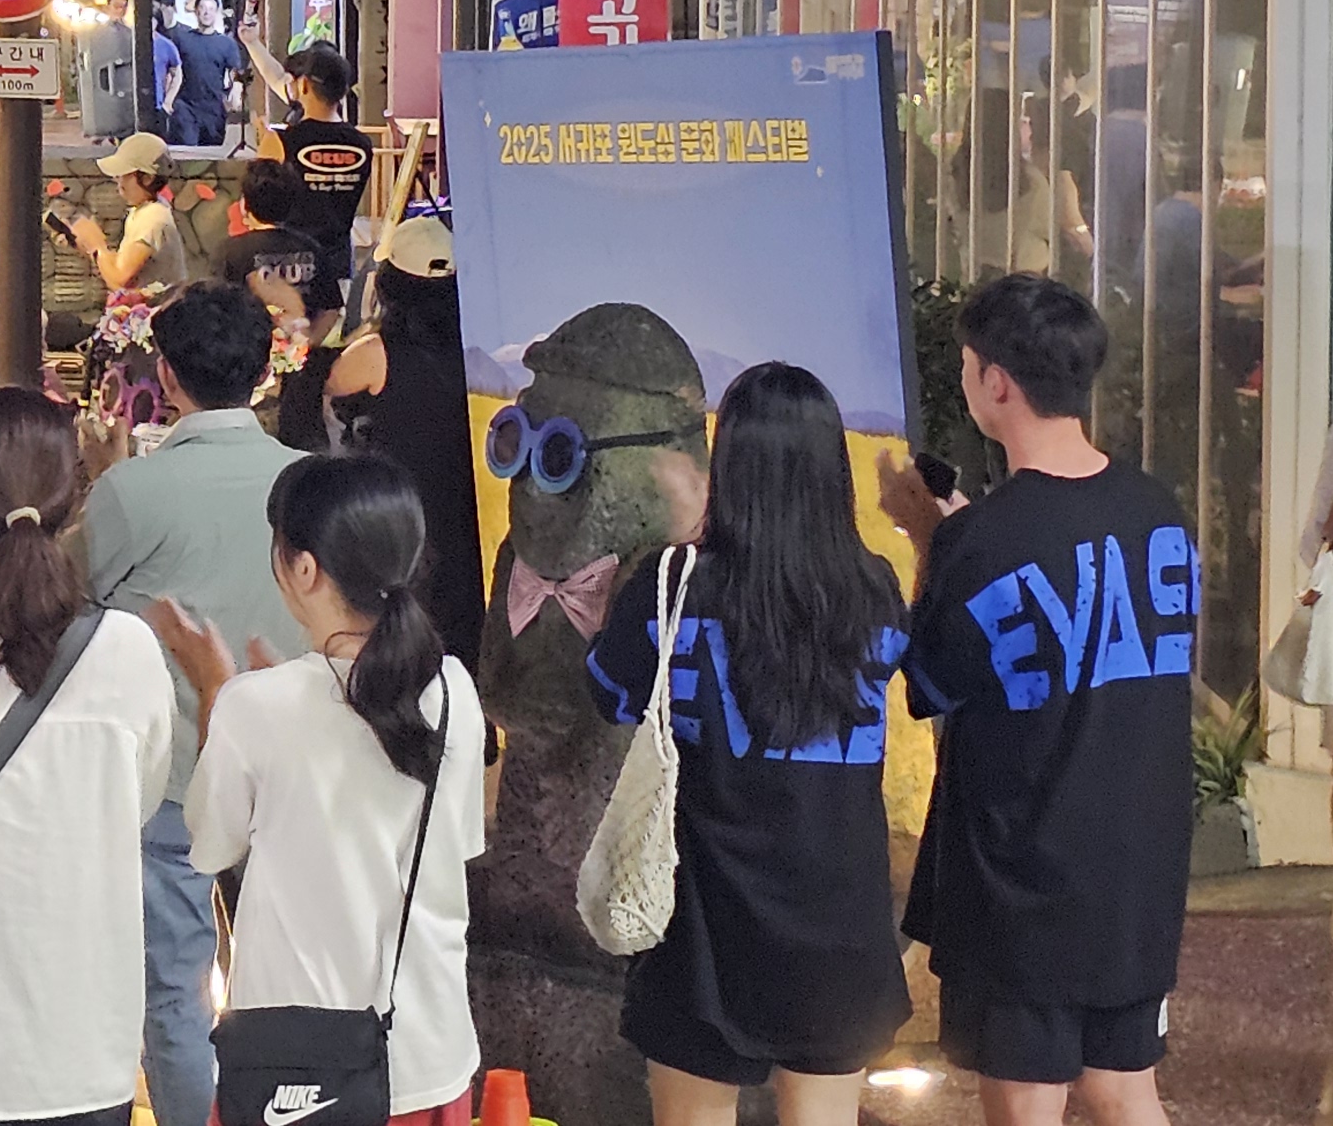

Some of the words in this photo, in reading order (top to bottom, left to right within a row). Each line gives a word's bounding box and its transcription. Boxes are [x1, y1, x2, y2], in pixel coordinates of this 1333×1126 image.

[2, 79, 34, 90] 100m
[499, 123, 554, 164] 2025
[558, 121, 614, 164] 서귀포
[617, 121, 676, 164] 원도심
[679, 119, 720, 163] 문화
[725, 118, 810, 163] 페스티벌
[273, 1085, 322, 1110] NIKE
